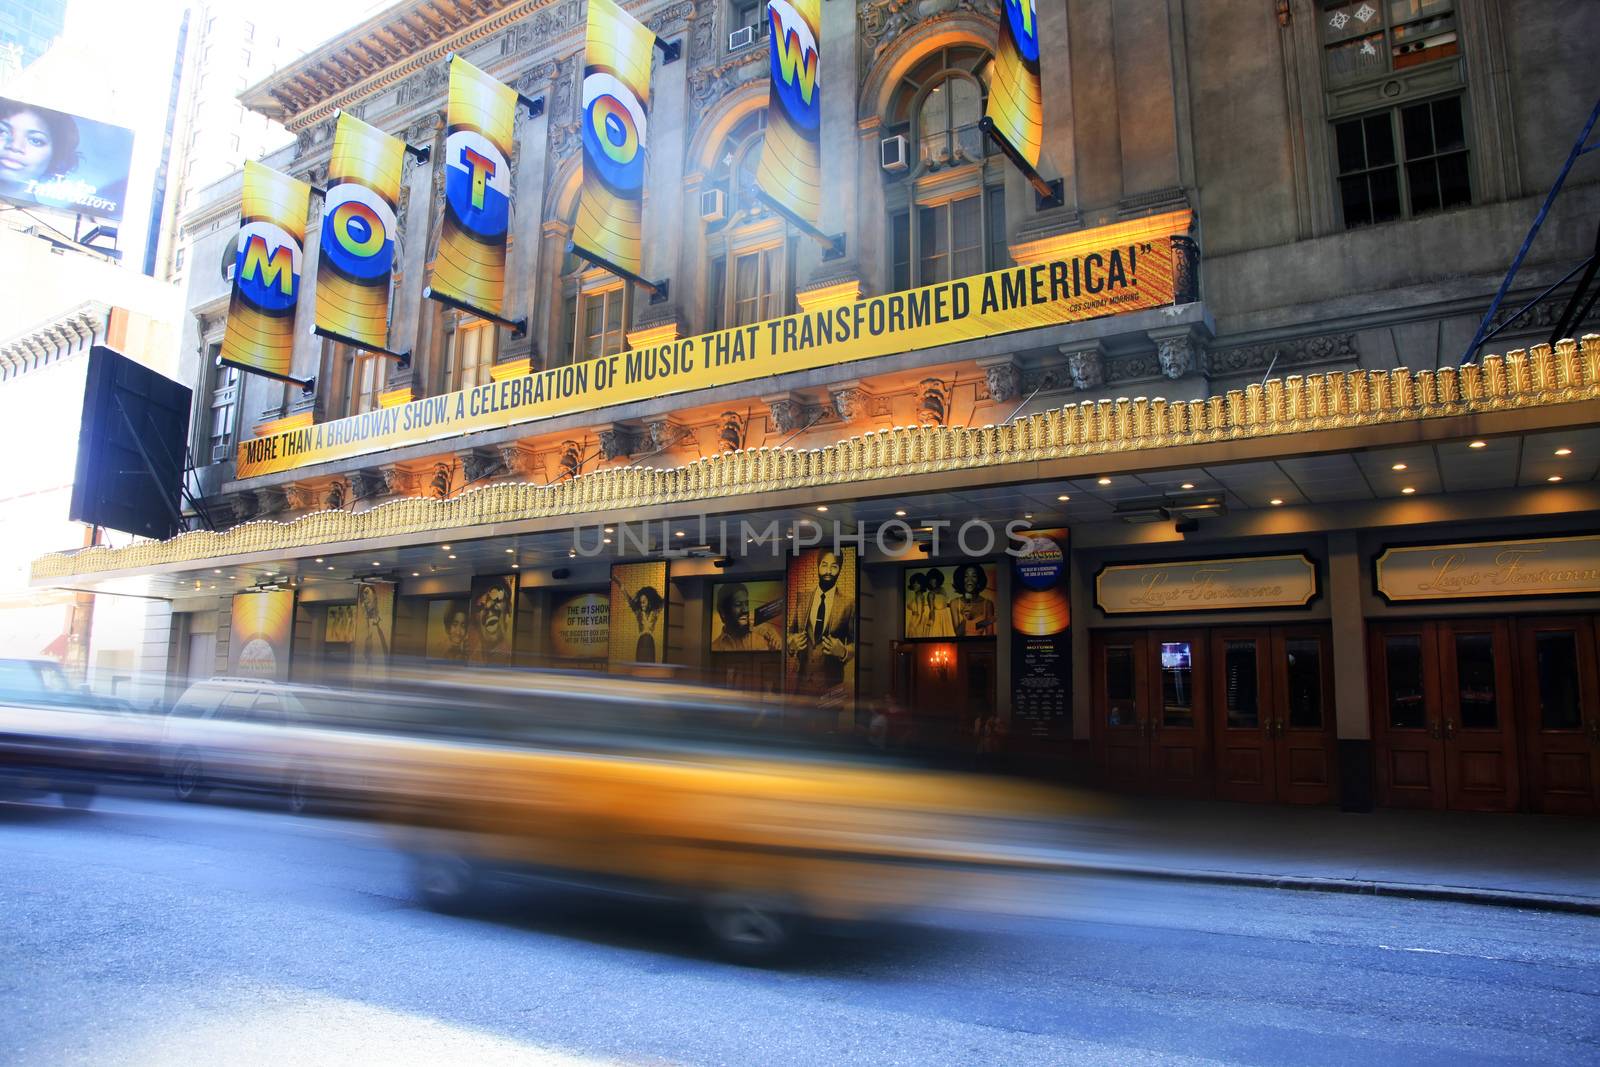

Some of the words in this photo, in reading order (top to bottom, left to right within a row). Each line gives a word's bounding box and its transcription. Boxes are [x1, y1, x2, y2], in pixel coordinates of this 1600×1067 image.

[1083, 298, 1108, 311] SUNDAY
[1110, 291, 1140, 305] MORNING
[281, 428, 313, 457] THAN
[315, 431, 323, 450] A
[327, 406, 400, 448] BROADWAY
[403, 395, 450, 431] SHOW,
[455, 394, 465, 420] A
[470, 363, 588, 417] CELEBRATION
[594, 356, 618, 391] OF
[625, 339, 694, 385] MUSIC
[701, 325, 760, 369] THAT
[767, 282, 970, 356] TRANSFORMED
[567, 606, 579, 616] THE
[581, 606, 590, 615] #1
[567, 616, 576, 626] OF
[577, 616, 590, 626] THE
